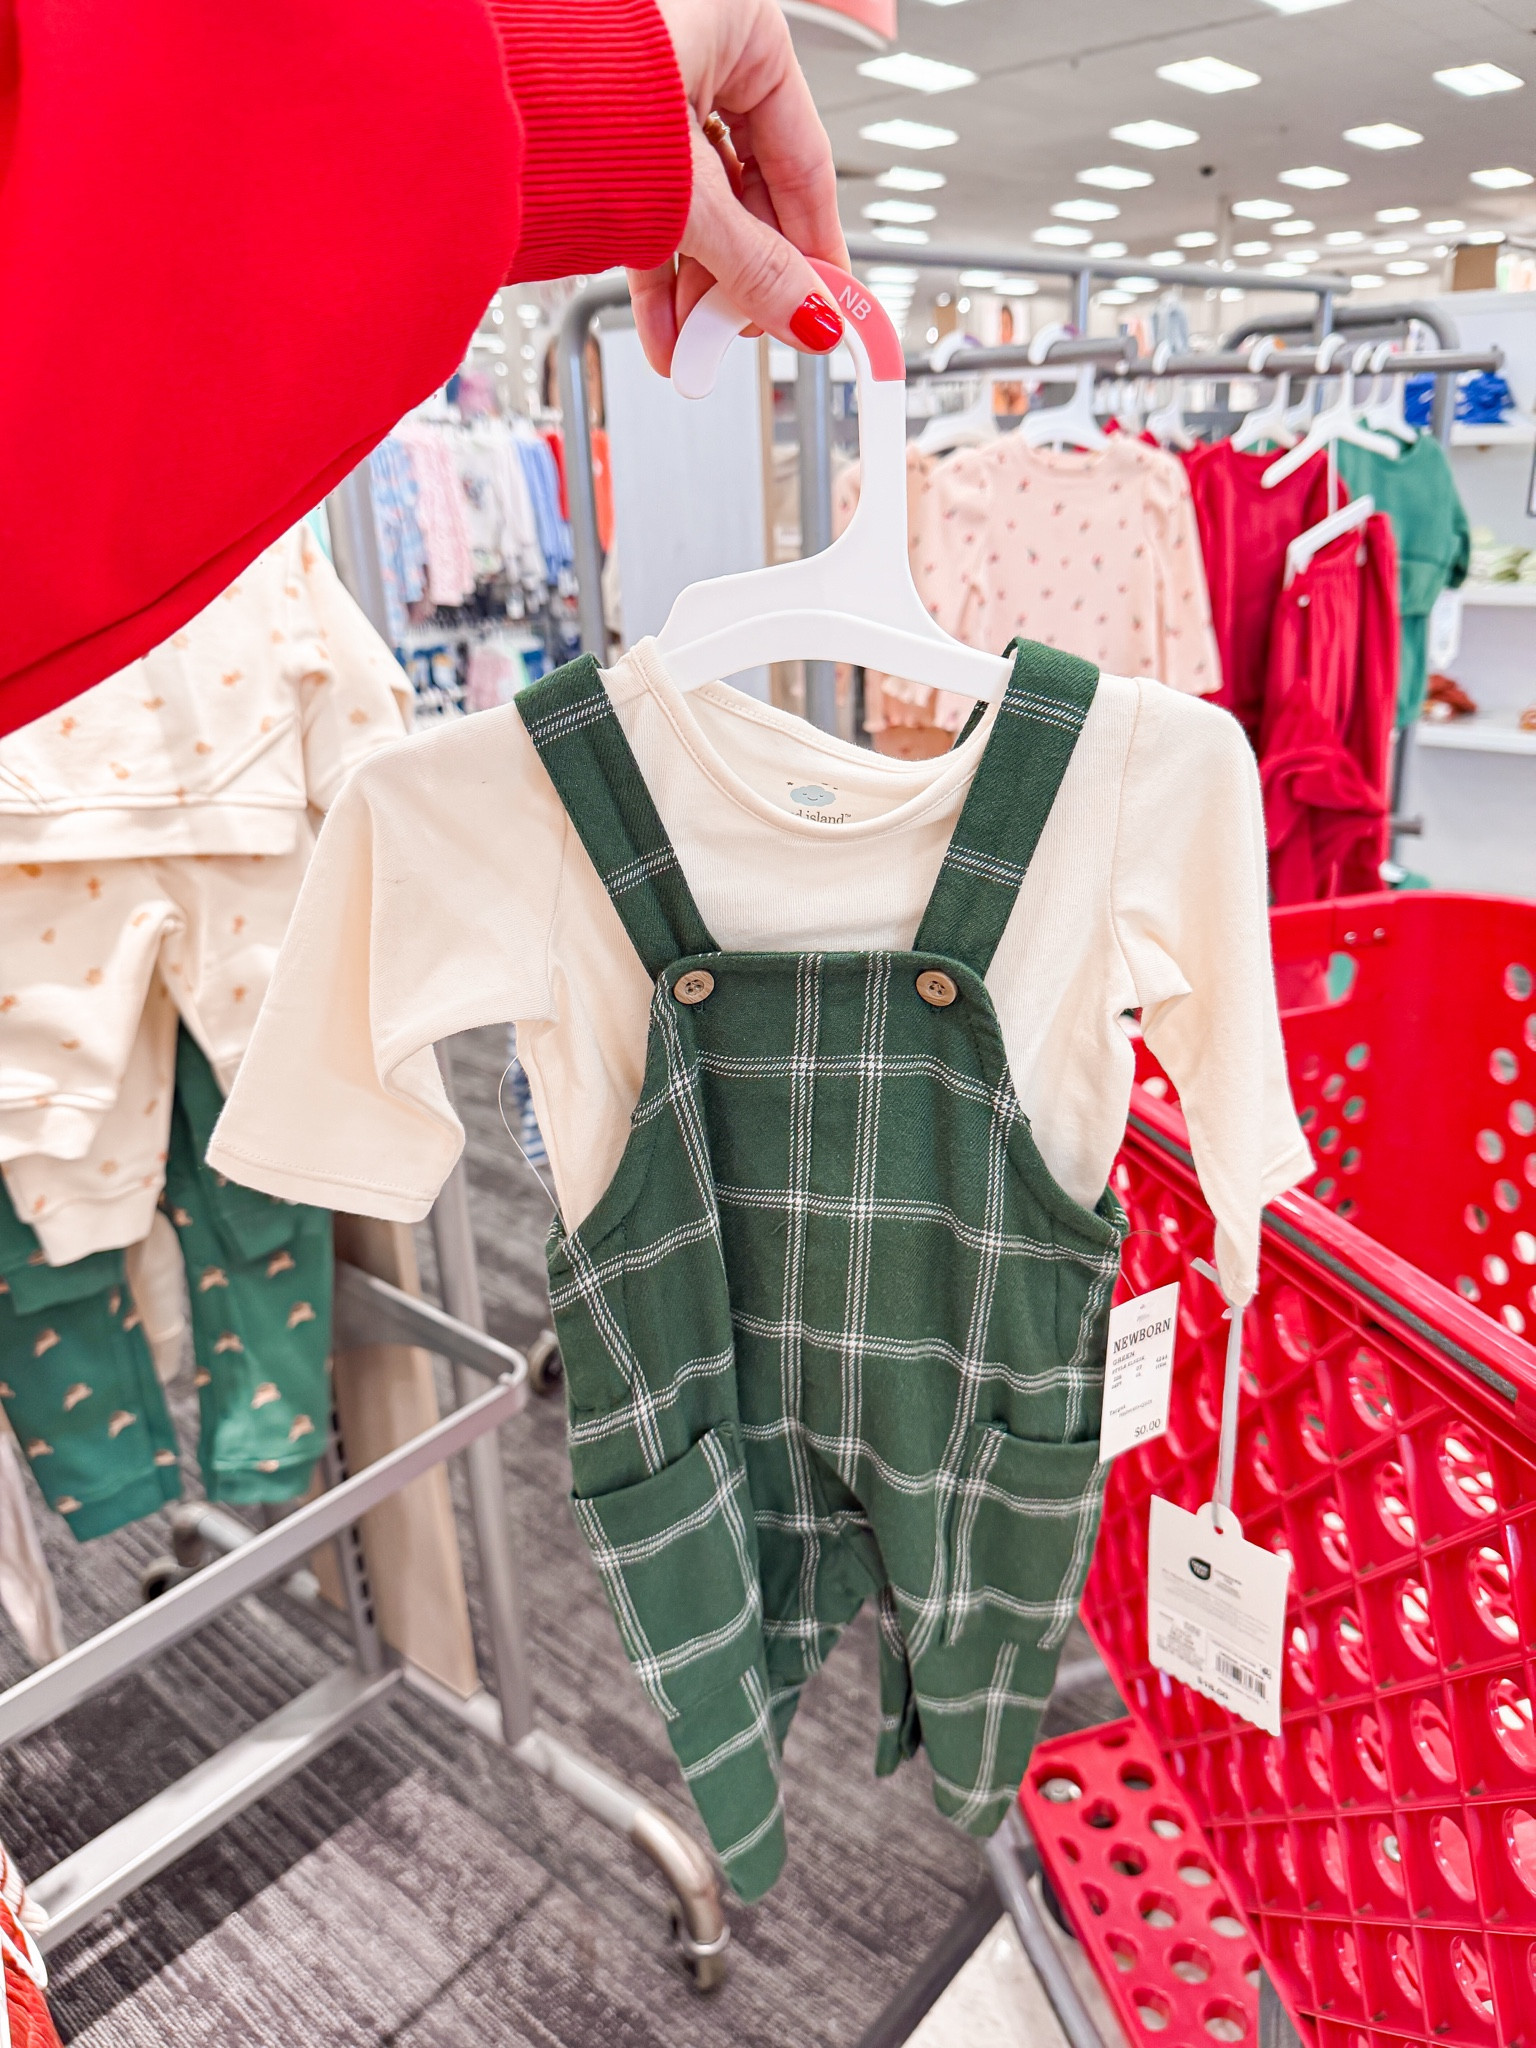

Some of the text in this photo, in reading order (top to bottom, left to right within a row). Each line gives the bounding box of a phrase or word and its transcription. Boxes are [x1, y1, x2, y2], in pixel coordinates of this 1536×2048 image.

[838, 284, 872, 321] NB
[1112, 1317, 1172, 1354] NEWBORN
[1112, 1350, 1135, 1366] GREEN
[1134, 1418, 1161, 1438] $0.00
